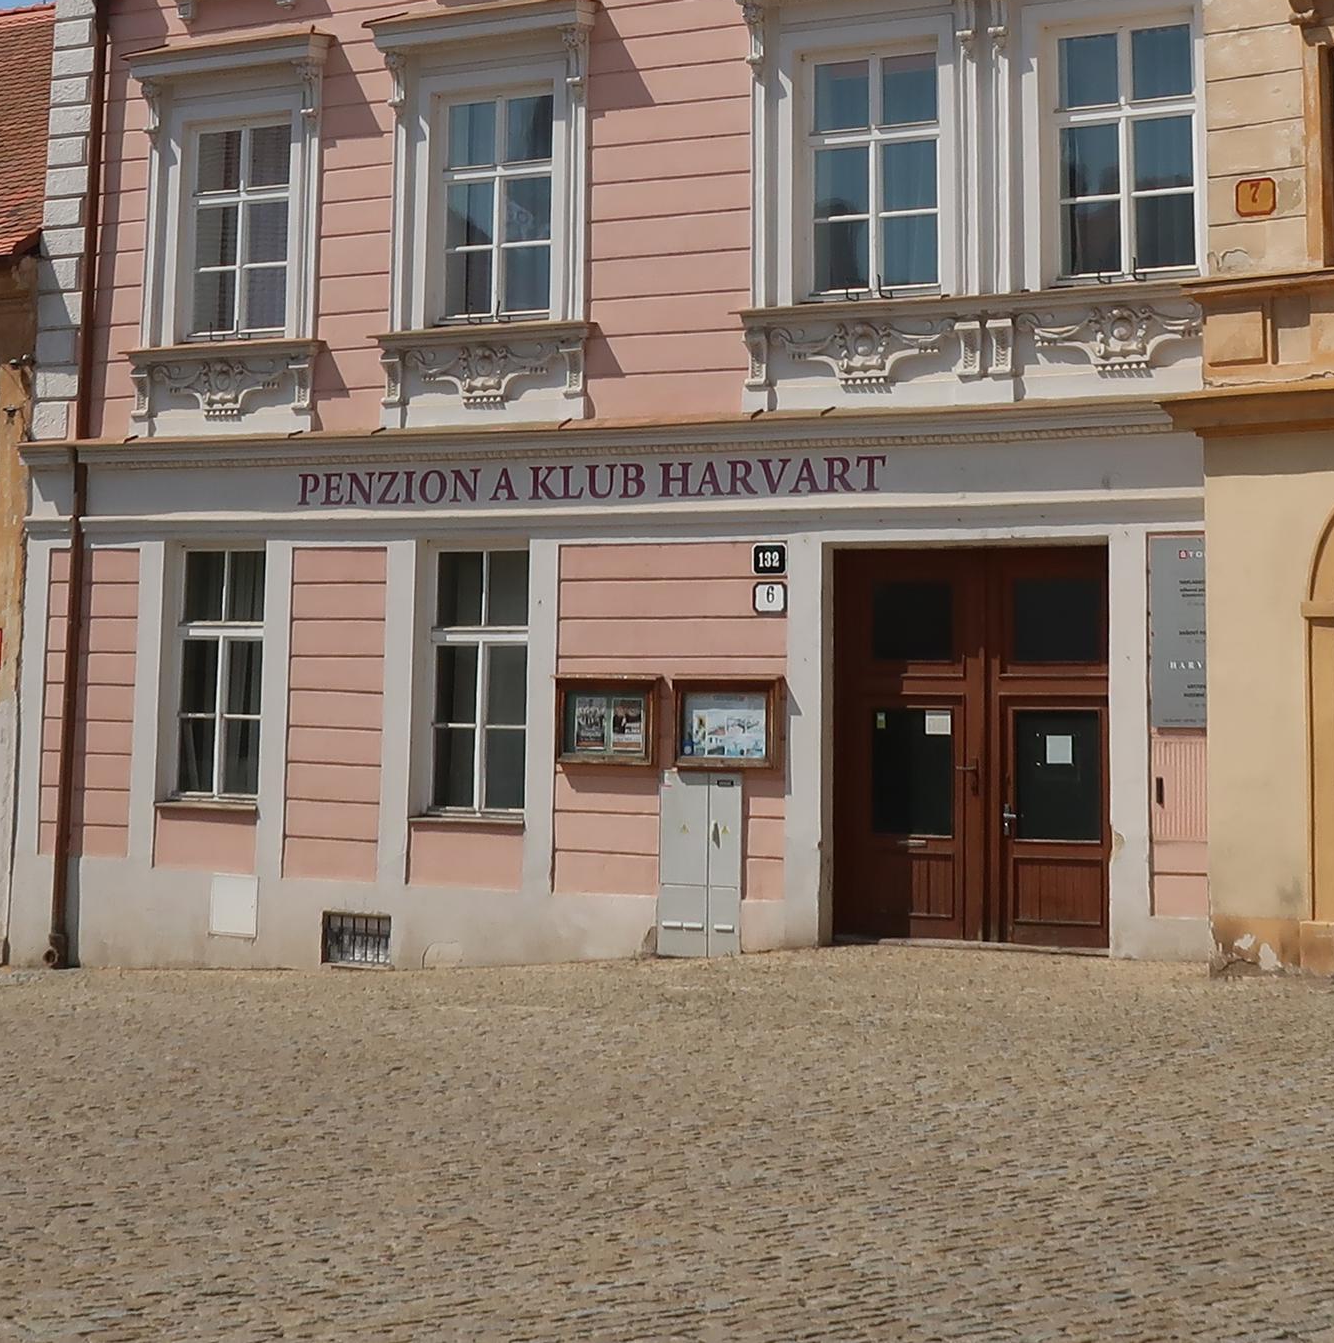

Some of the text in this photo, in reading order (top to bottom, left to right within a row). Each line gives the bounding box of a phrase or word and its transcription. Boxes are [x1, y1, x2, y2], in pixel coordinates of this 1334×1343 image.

[1250, 182, 1260, 203] 7
[298, 455, 887, 506] PENZION A KLUB HARVART
[759, 552, 779, 568] 132
[766, 586, 775, 603] 6
